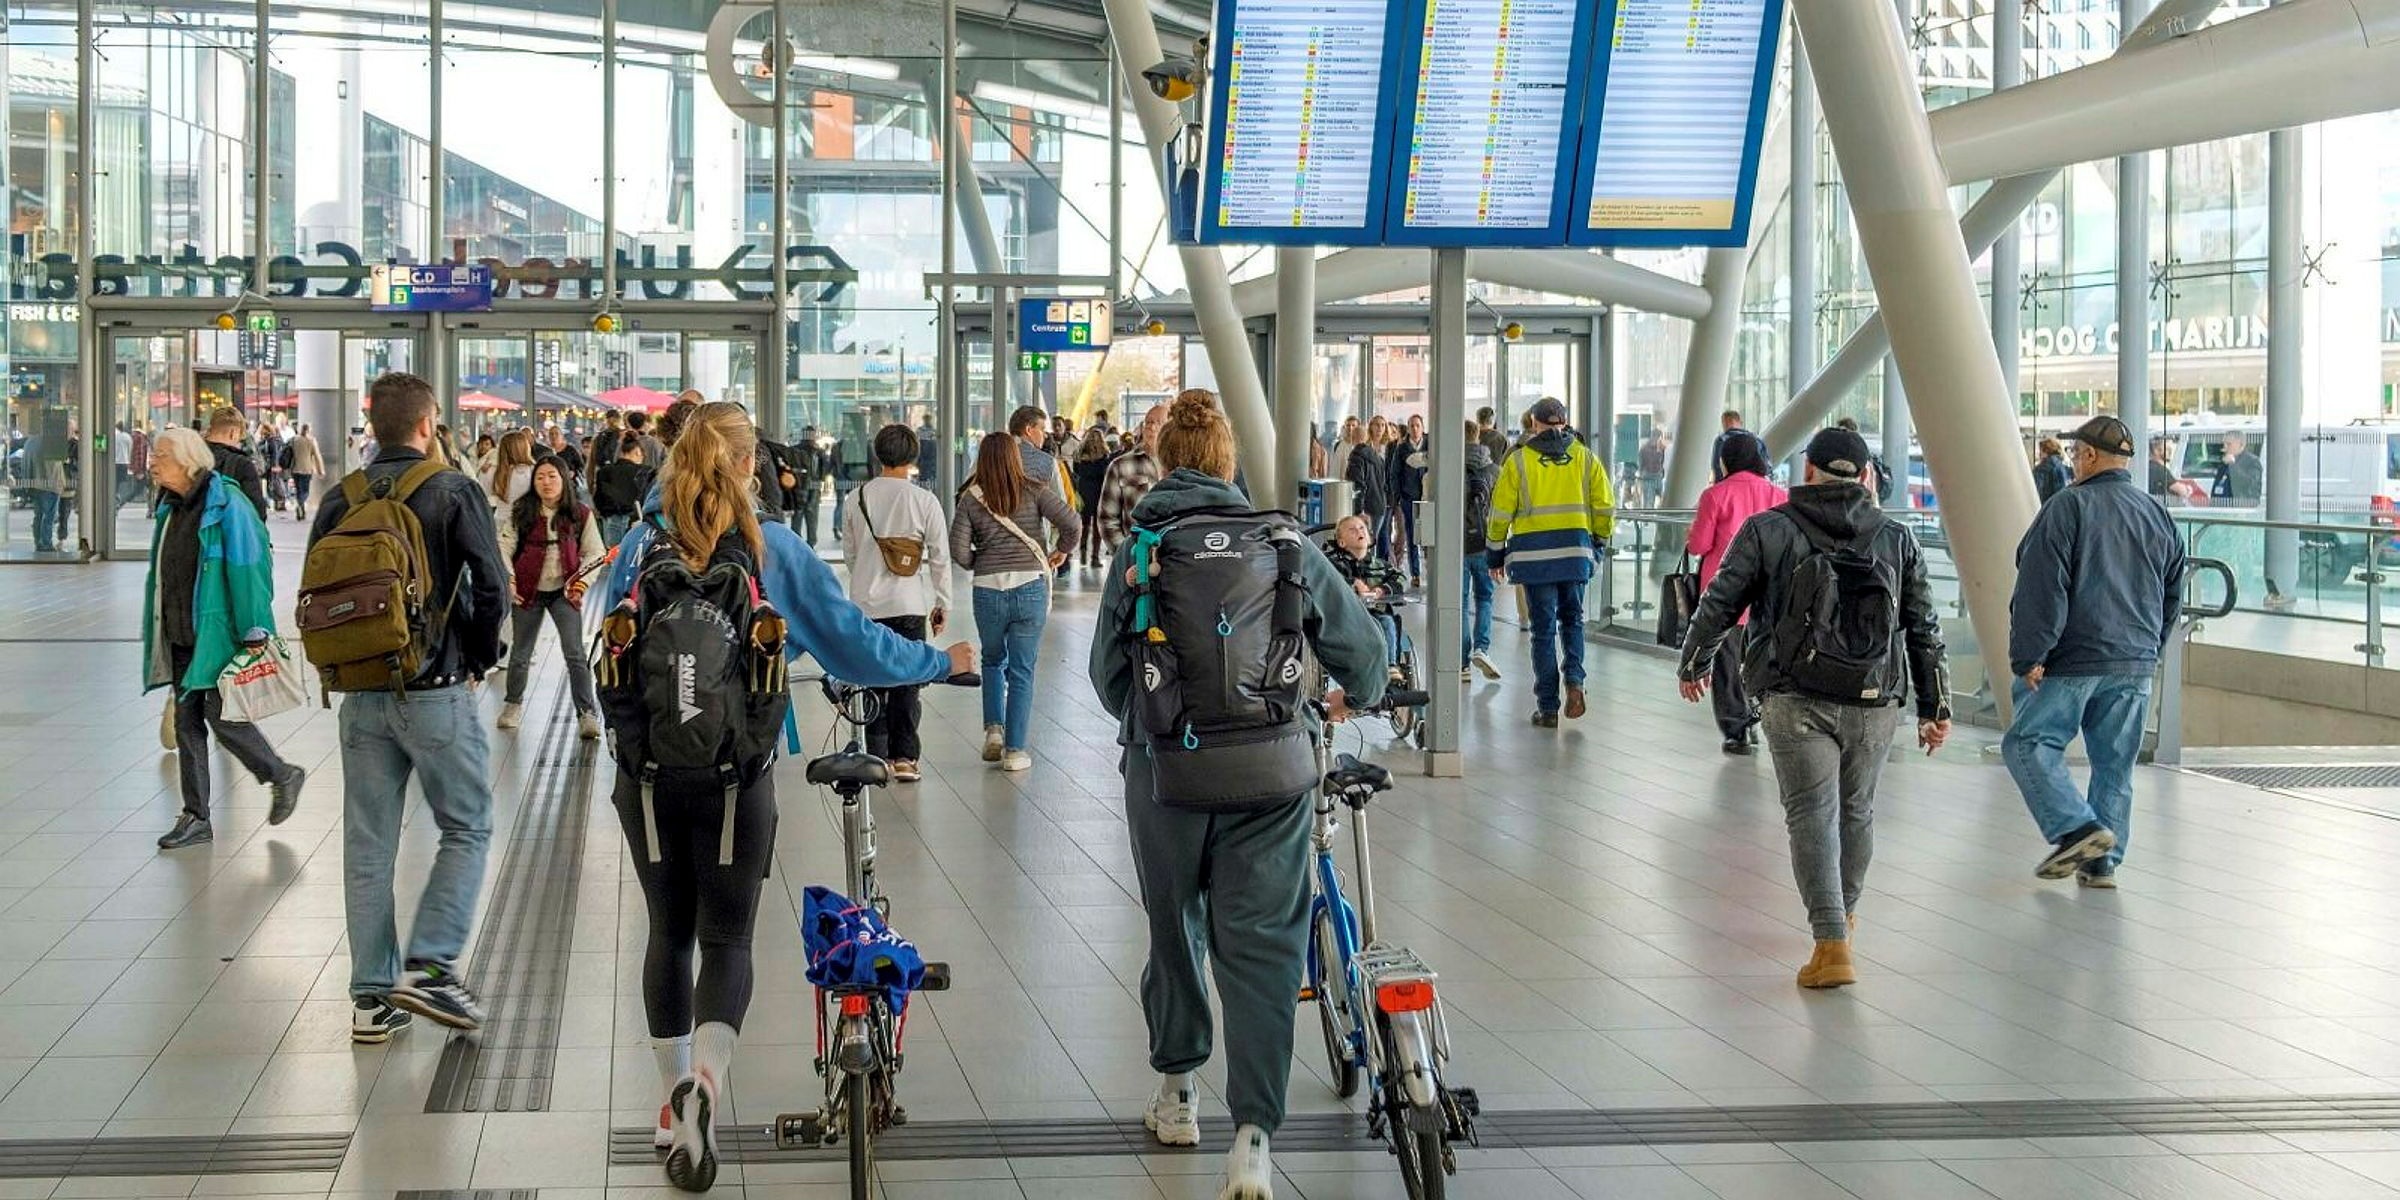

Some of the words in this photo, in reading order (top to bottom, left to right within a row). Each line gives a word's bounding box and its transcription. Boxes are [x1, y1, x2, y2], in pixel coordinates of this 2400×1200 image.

[11, 305, 45, 321] FISH
[47, 304, 60, 322] &
[1031, 323, 1067, 333] Centrum
[2019, 323, 2096, 358] HOOG
[678, 653, 704, 724] VIKING
